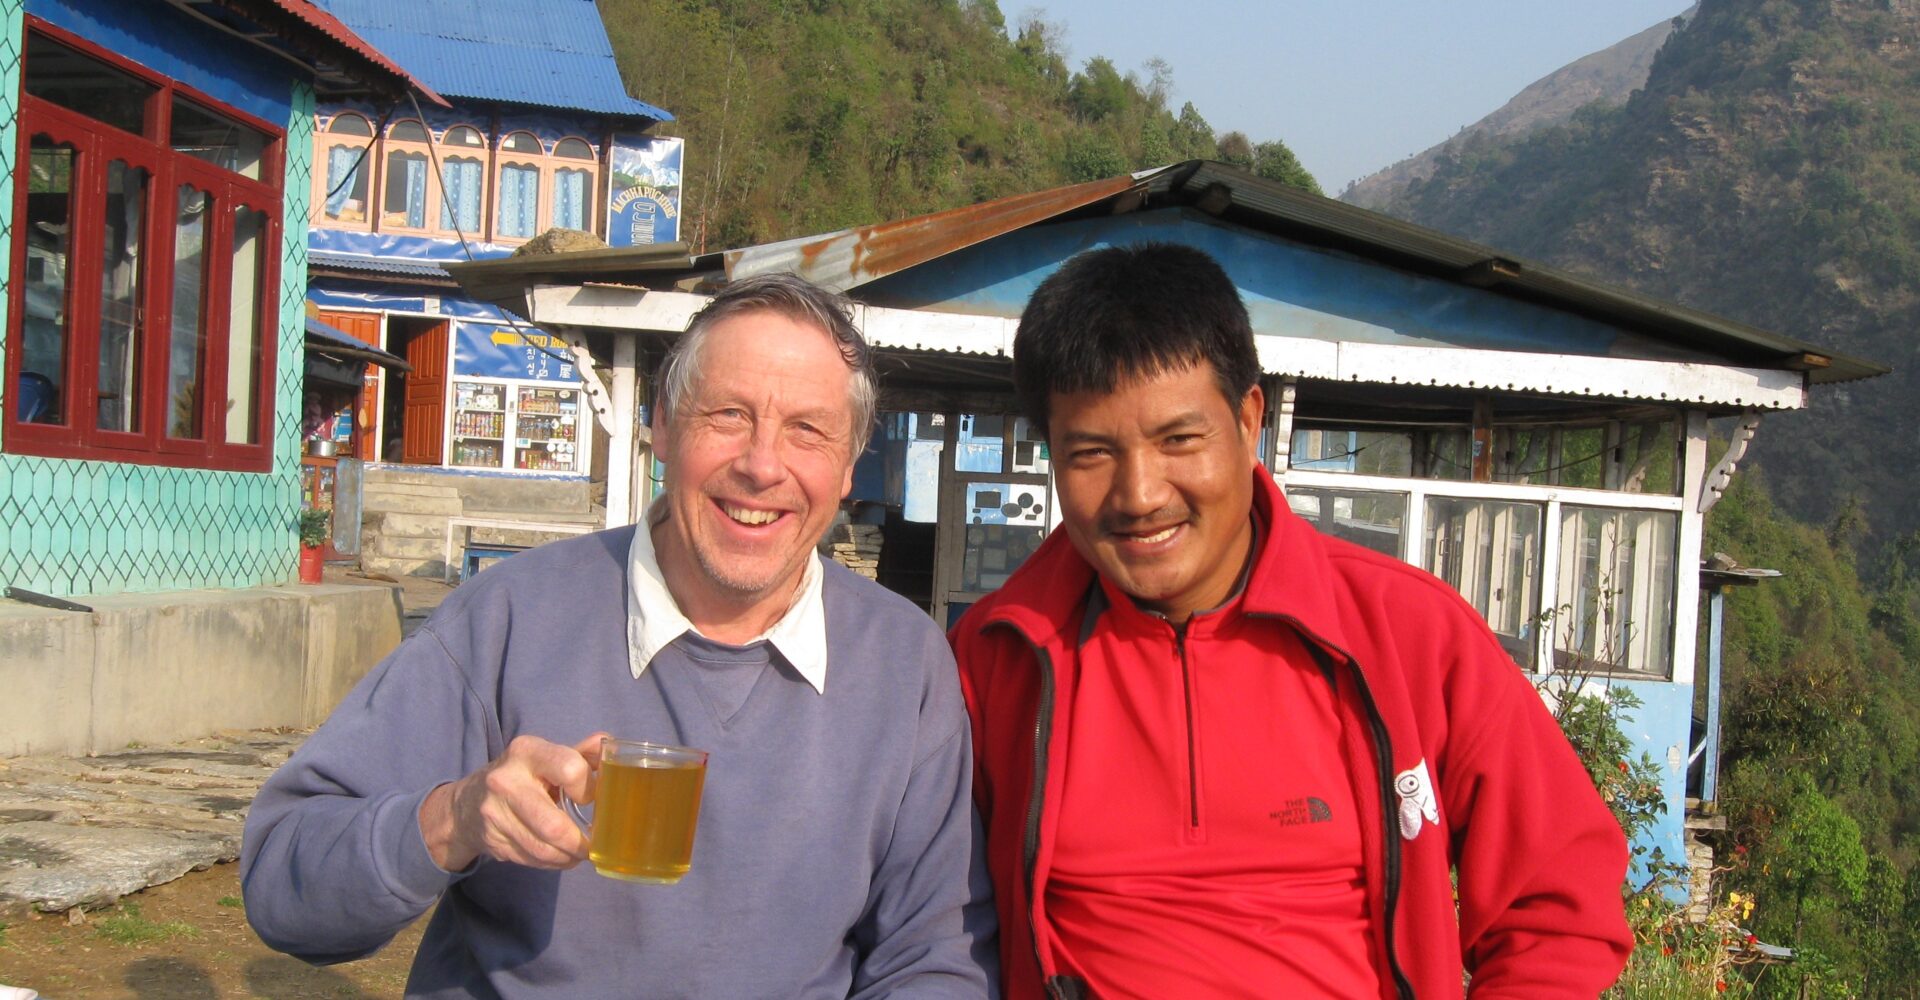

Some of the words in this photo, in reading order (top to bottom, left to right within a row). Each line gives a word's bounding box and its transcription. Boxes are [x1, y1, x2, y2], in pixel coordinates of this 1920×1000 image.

[1285, 798, 1304, 808] THE
[1269, 807, 1307, 820] NORTH
[1280, 816, 1307, 828] FACE
